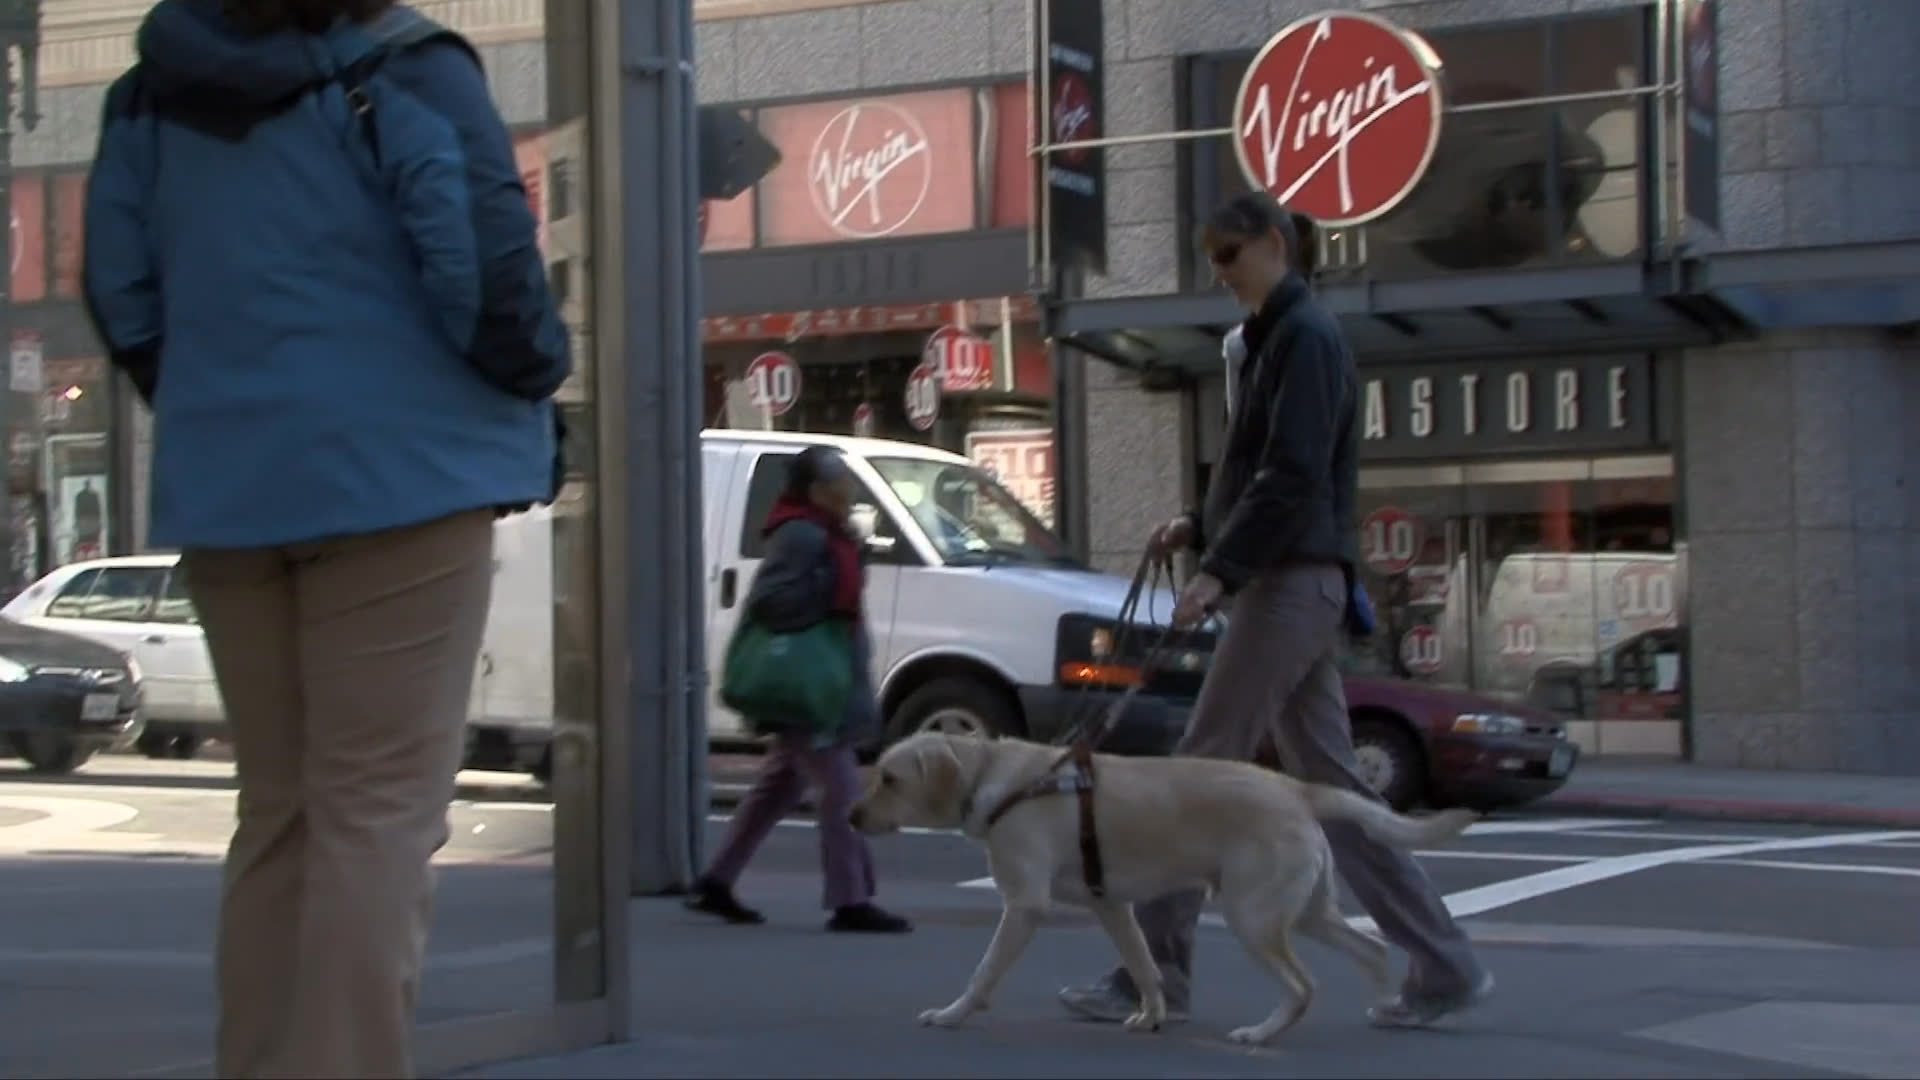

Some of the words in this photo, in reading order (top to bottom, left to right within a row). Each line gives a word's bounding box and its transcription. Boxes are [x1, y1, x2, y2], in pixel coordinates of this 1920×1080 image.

[1244, 17, 1431, 213] Virgin
[815, 105, 927, 224] Virgin
[751, 364, 793, 406] 10
[1367, 519, 1414, 561] 10
[1620, 574, 1672, 617] 10
[1407, 636, 1440, 665] 10
[1502, 622, 1536, 655] 10
